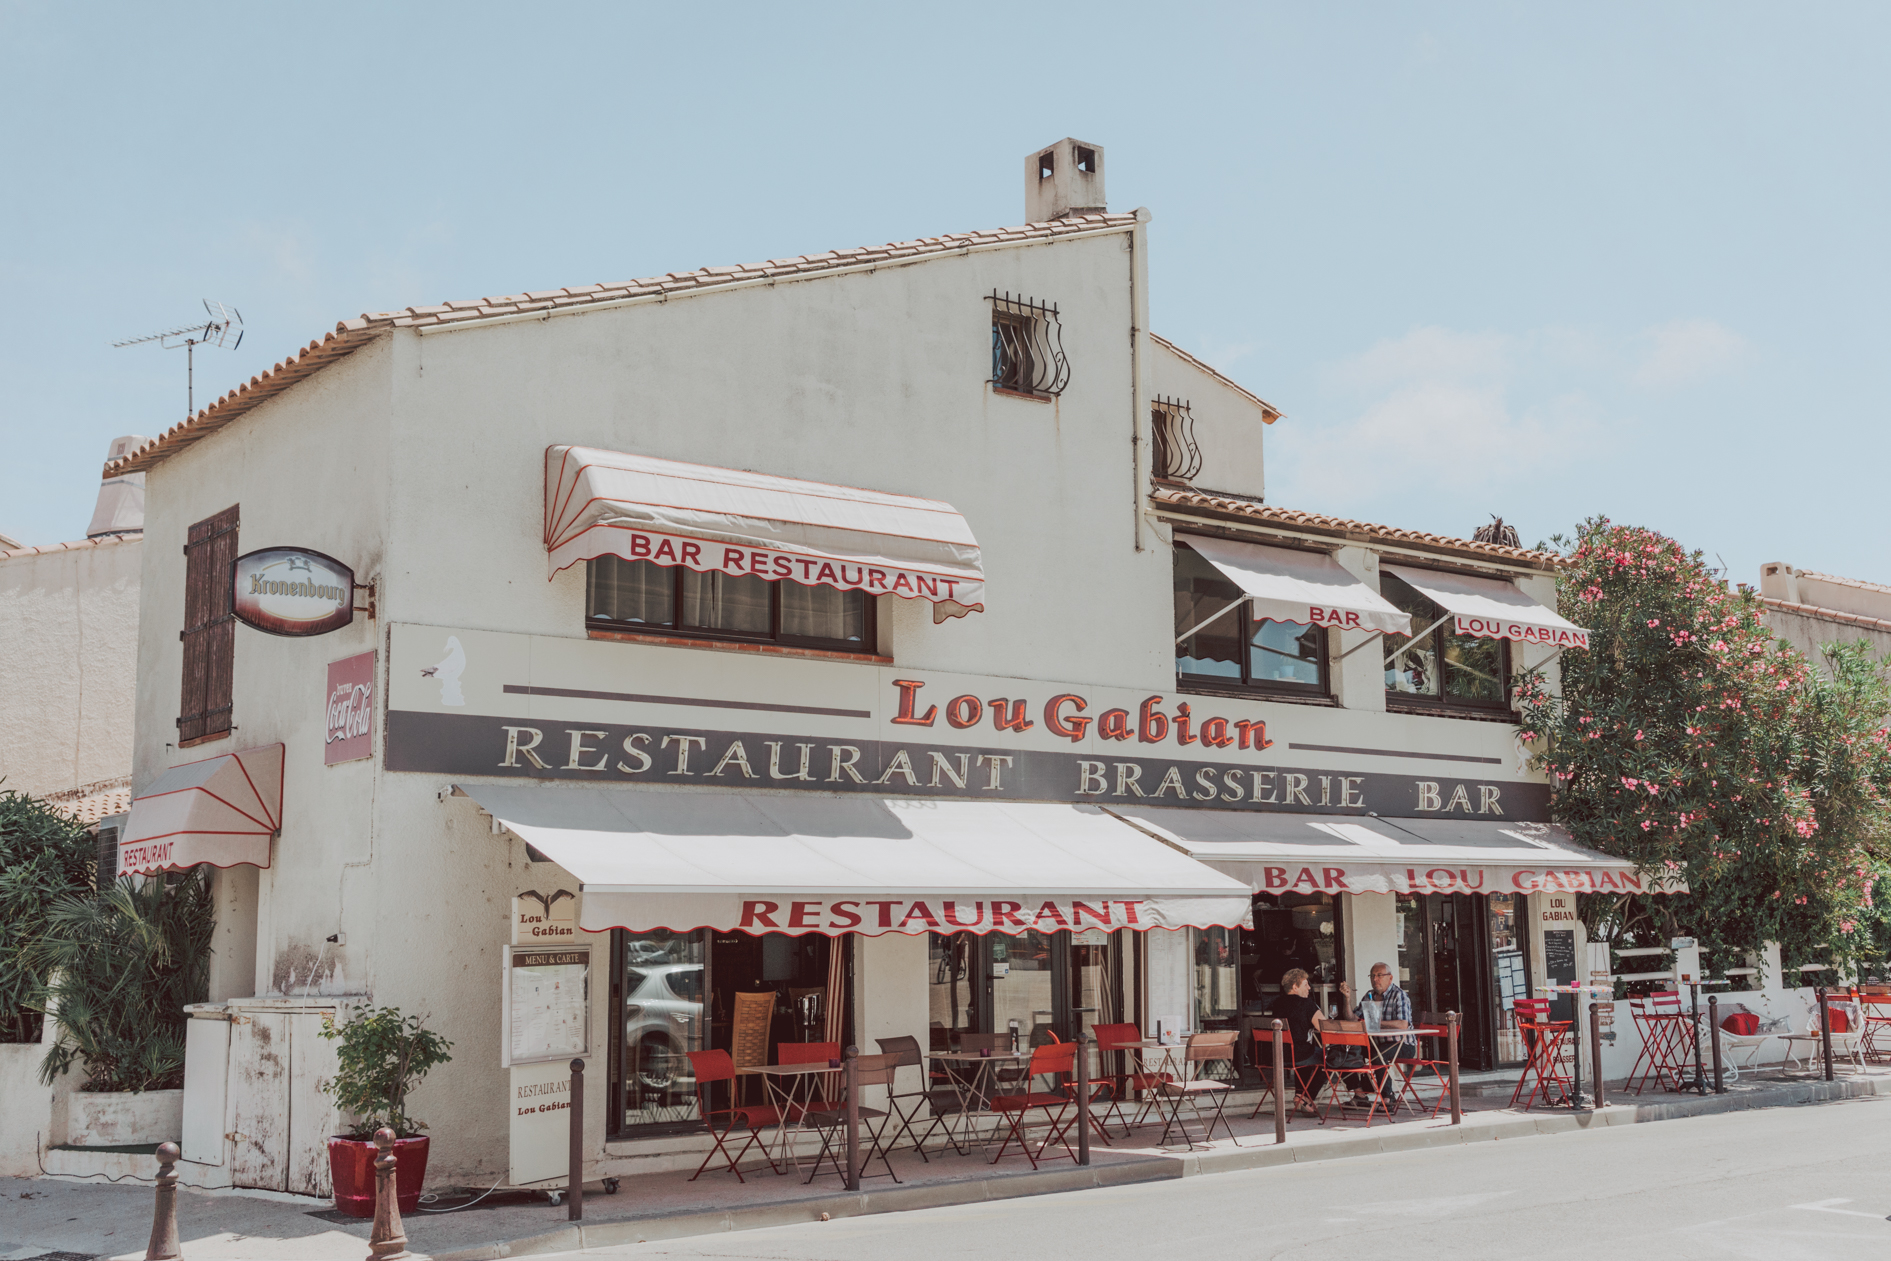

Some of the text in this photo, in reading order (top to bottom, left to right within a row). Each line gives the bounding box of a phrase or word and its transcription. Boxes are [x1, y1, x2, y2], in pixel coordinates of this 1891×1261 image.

[630, 533, 960, 599] BAR RESTAURANT
[249, 573, 345, 607] Kronenbourg
[1309, 606, 1360, 627] BAR
[1457, 617, 1587, 647] LOU GABIAN
[891, 679, 1274, 751] Lou Gabian
[498, 726, 1504, 815] RESTAURANT BRASSERIE BAR
[124, 842, 174, 867] RESTAURANT
[1264, 866, 1642, 889] BAR LOU GABIAN
[739, 900, 1144, 928] RESTAURANT
[1550, 899, 1566, 908] LOU
[520, 914, 542, 923] Lou
[1542, 911, 1574, 920] GABIAN
[532, 925, 573, 937] Gabian
[525, 953, 579, 965] MENU & CARTE
[518, 1080, 571, 1098] RESTAURANT
[518, 1101, 571, 1115] Lou Gabian
